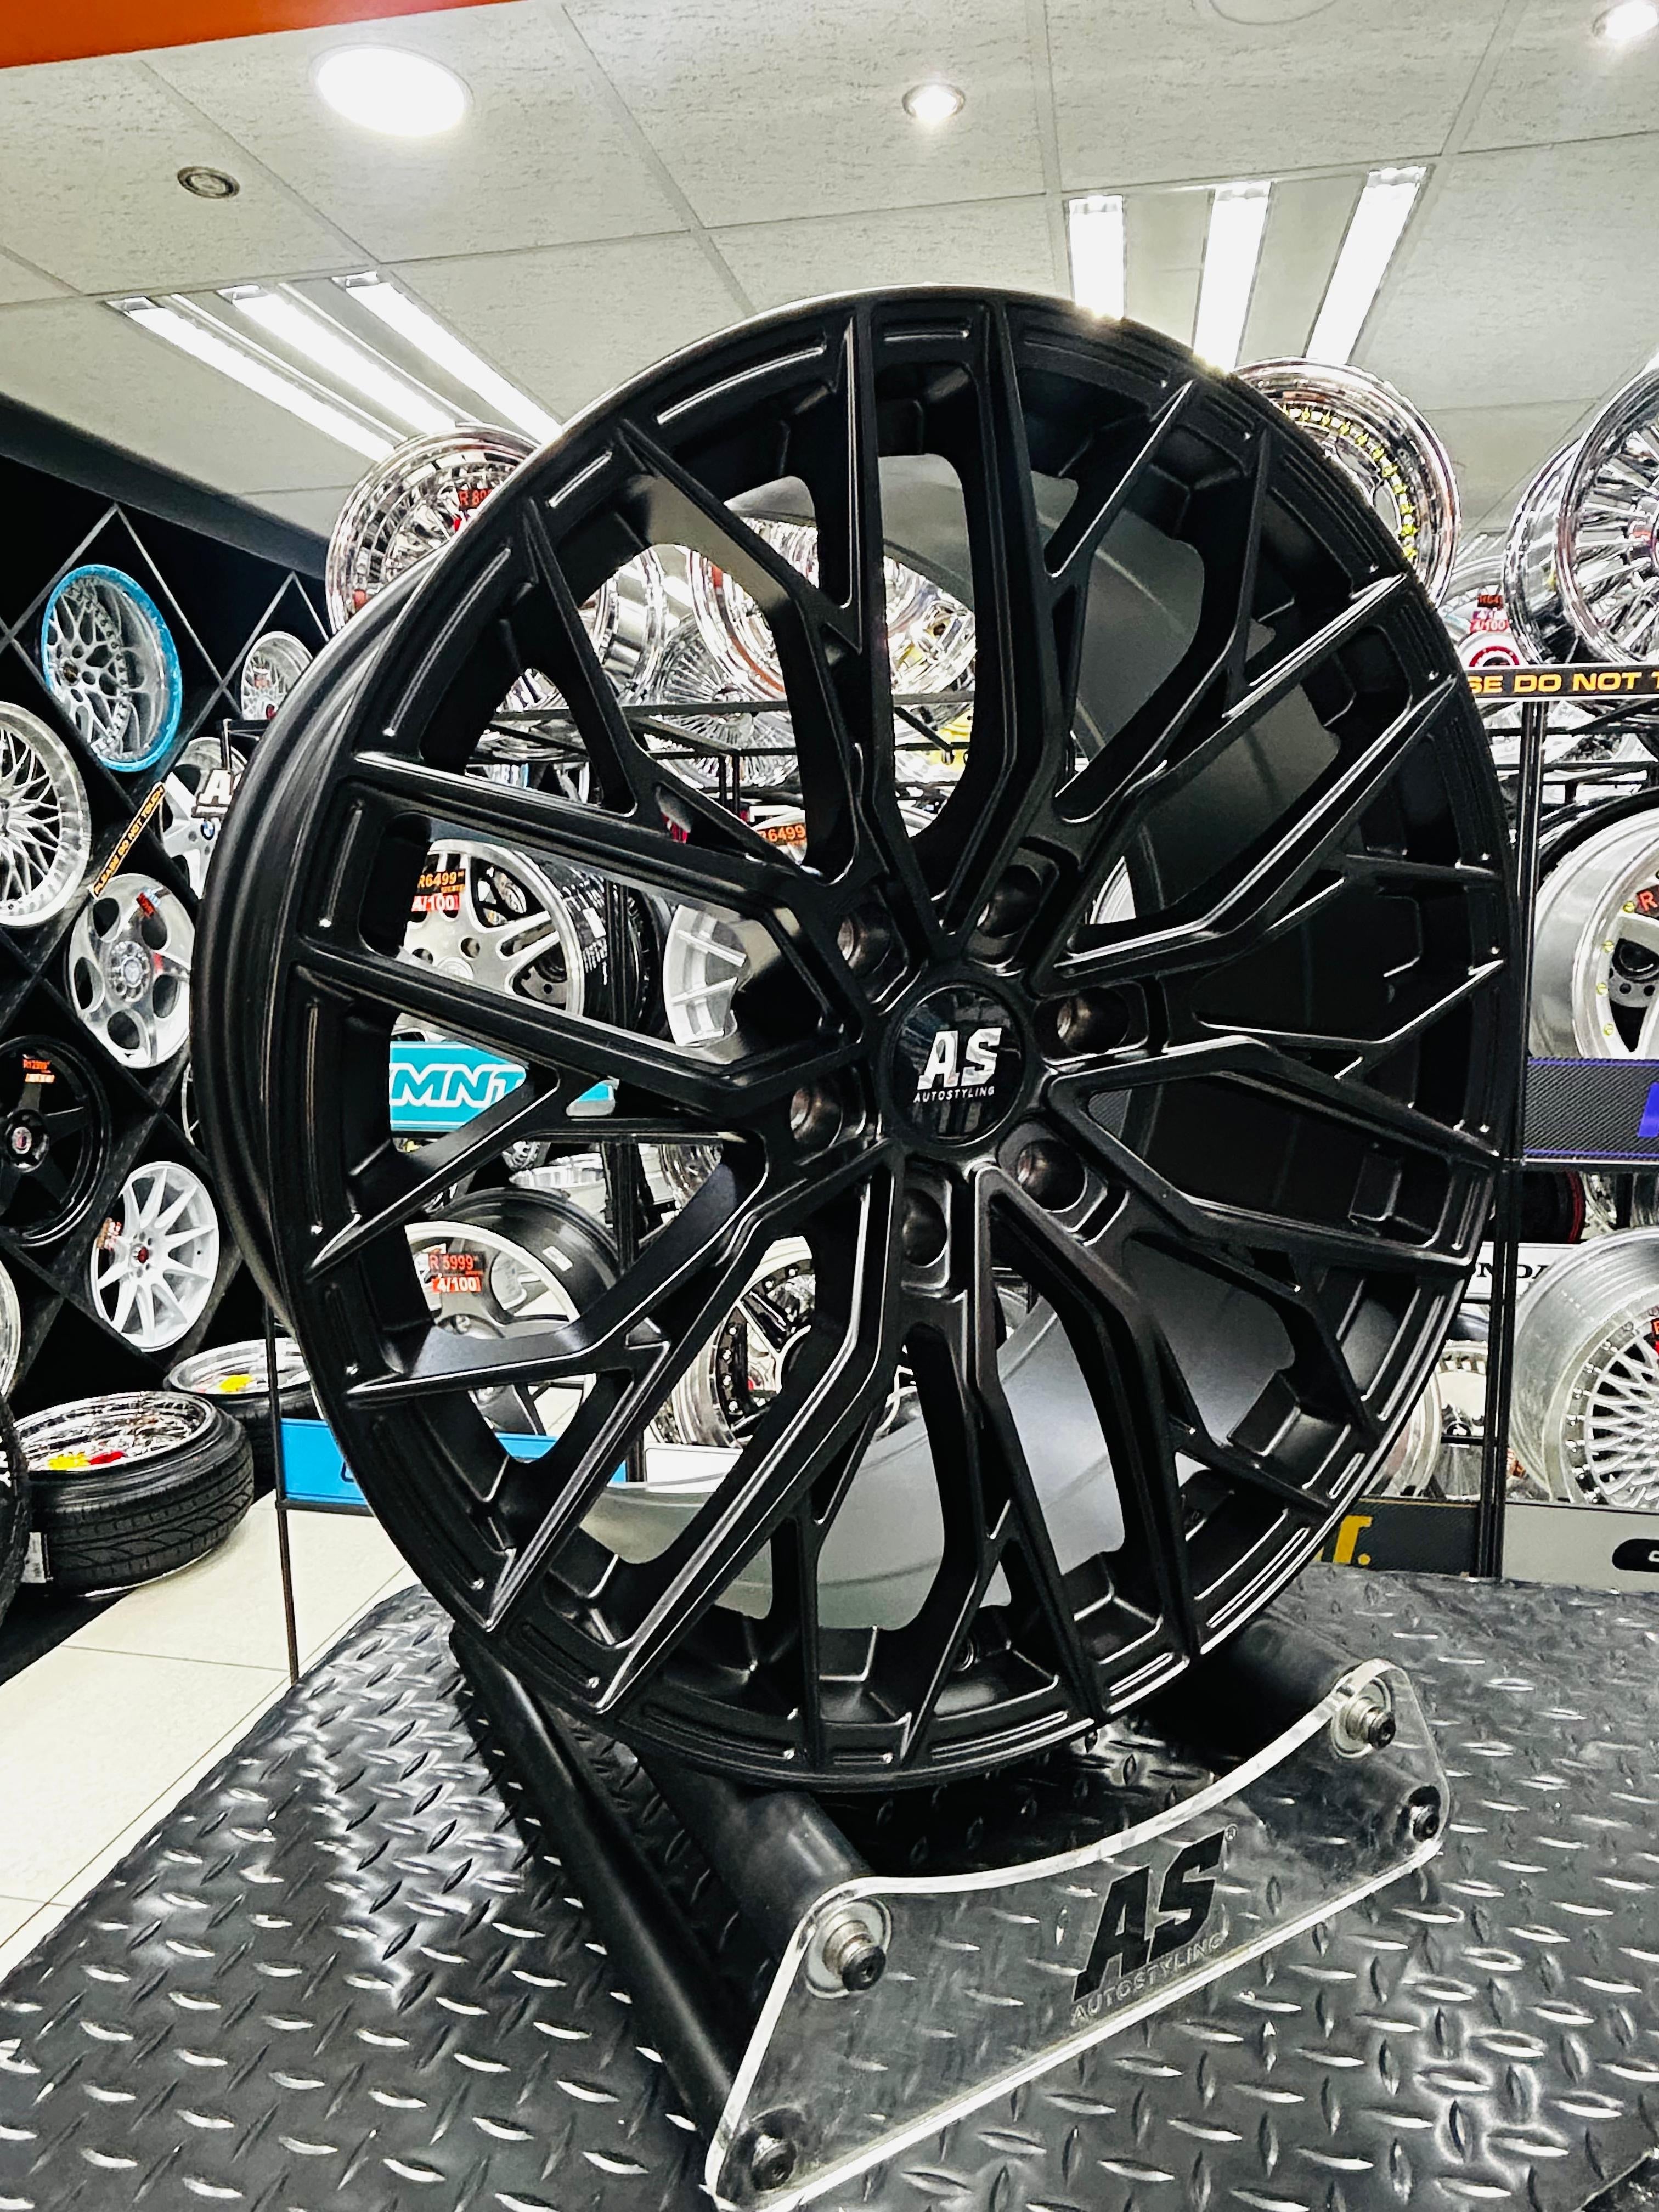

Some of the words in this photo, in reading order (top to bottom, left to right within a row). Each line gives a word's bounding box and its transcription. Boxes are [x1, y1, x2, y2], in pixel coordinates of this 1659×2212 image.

[1513, 674, 1562, 693] DO
[1572, 672, 1643, 691] NOT
[199, 769, 242, 805] A
[118, 840, 129, 856] DO
[127, 819, 143, 840] NOT
[411, 894, 455, 912] 4/100
[917, 1027, 1002, 1090] AS
[913, 1085, 995, 1103] AUTOSTYLING
[429, 1254, 439, 1270] R
[437, 1276, 478, 1293] 4/100
[1070, 1932, 1228, 2027] AUTOSTYLING
